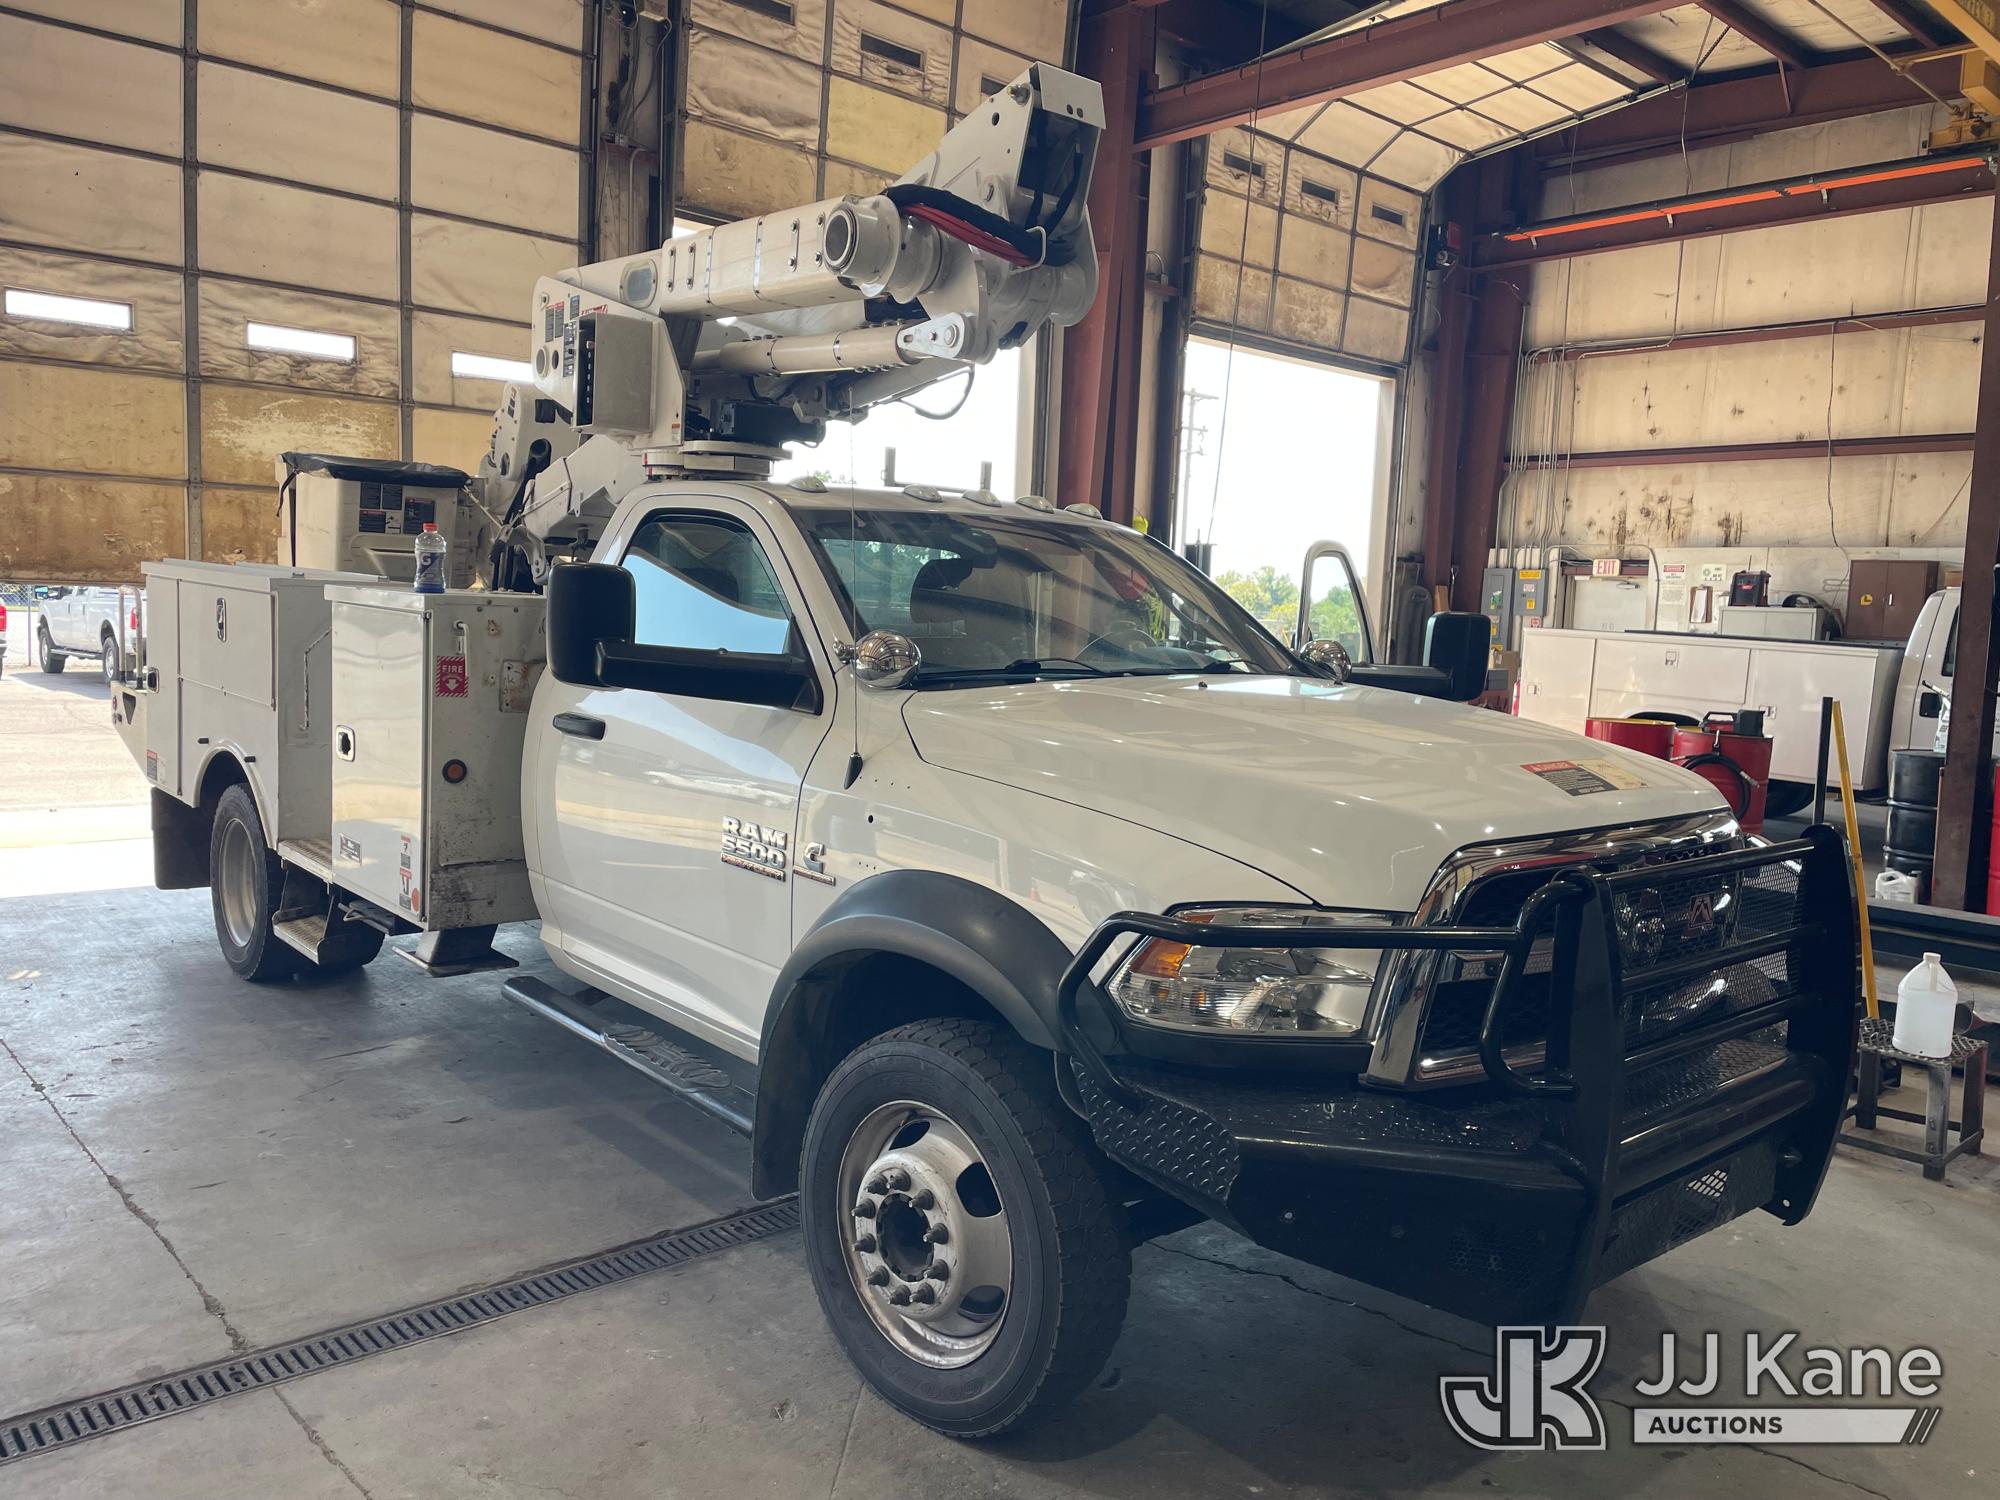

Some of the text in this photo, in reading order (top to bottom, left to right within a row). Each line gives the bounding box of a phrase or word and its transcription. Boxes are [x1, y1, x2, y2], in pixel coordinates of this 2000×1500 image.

[1597, 560, 1617, 576] EXIT
[442, 664, 464, 674] FIRE
[723, 816, 788, 850] RAM
[721, 834, 786, 870] 5500
